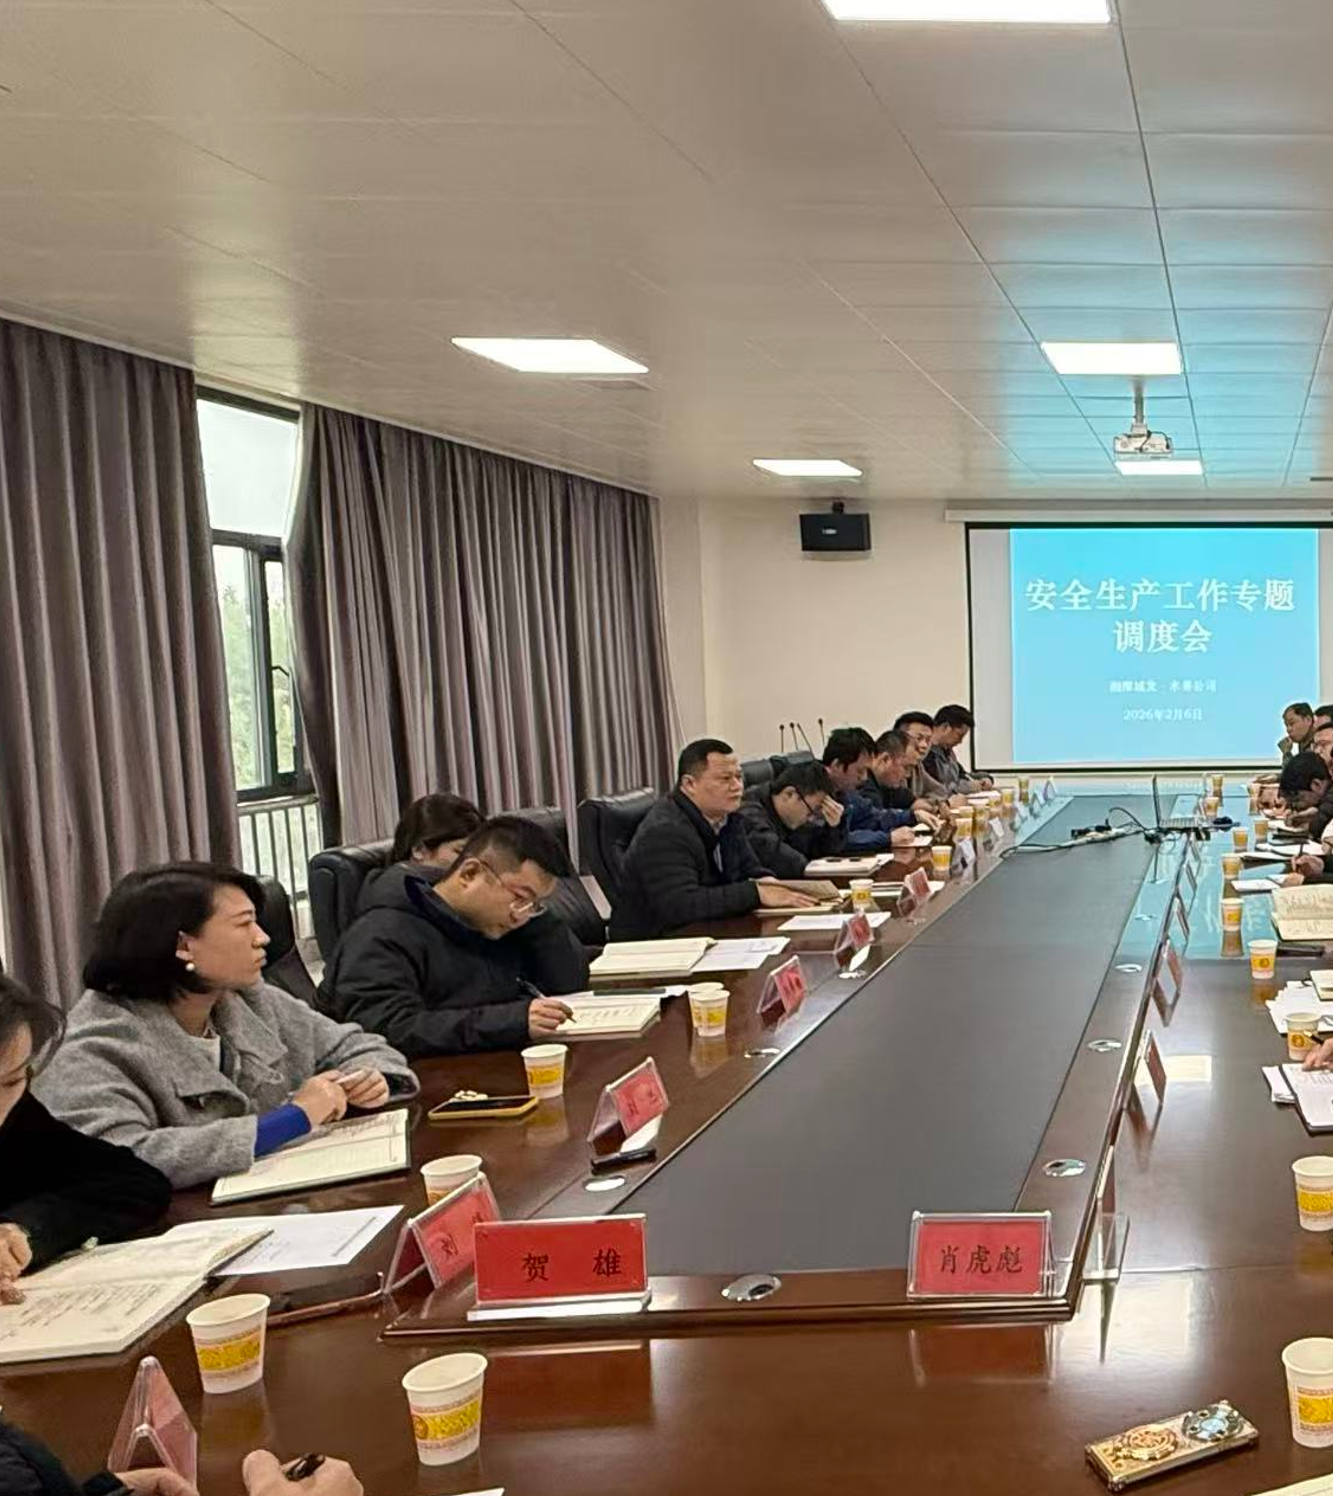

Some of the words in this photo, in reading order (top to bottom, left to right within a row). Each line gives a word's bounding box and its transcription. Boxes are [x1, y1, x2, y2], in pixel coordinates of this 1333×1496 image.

[1026, 578, 1295, 612] 安全生产工作专题
[1113, 619, 1213, 653] 调度会
[1123, 708, 1203, 721] 2026年2月6日
[523, 1252, 549, 1283] 贺
[592, 1248, 622, 1278] 雄
[940, 1244, 1024, 1275] 肖虎彪
